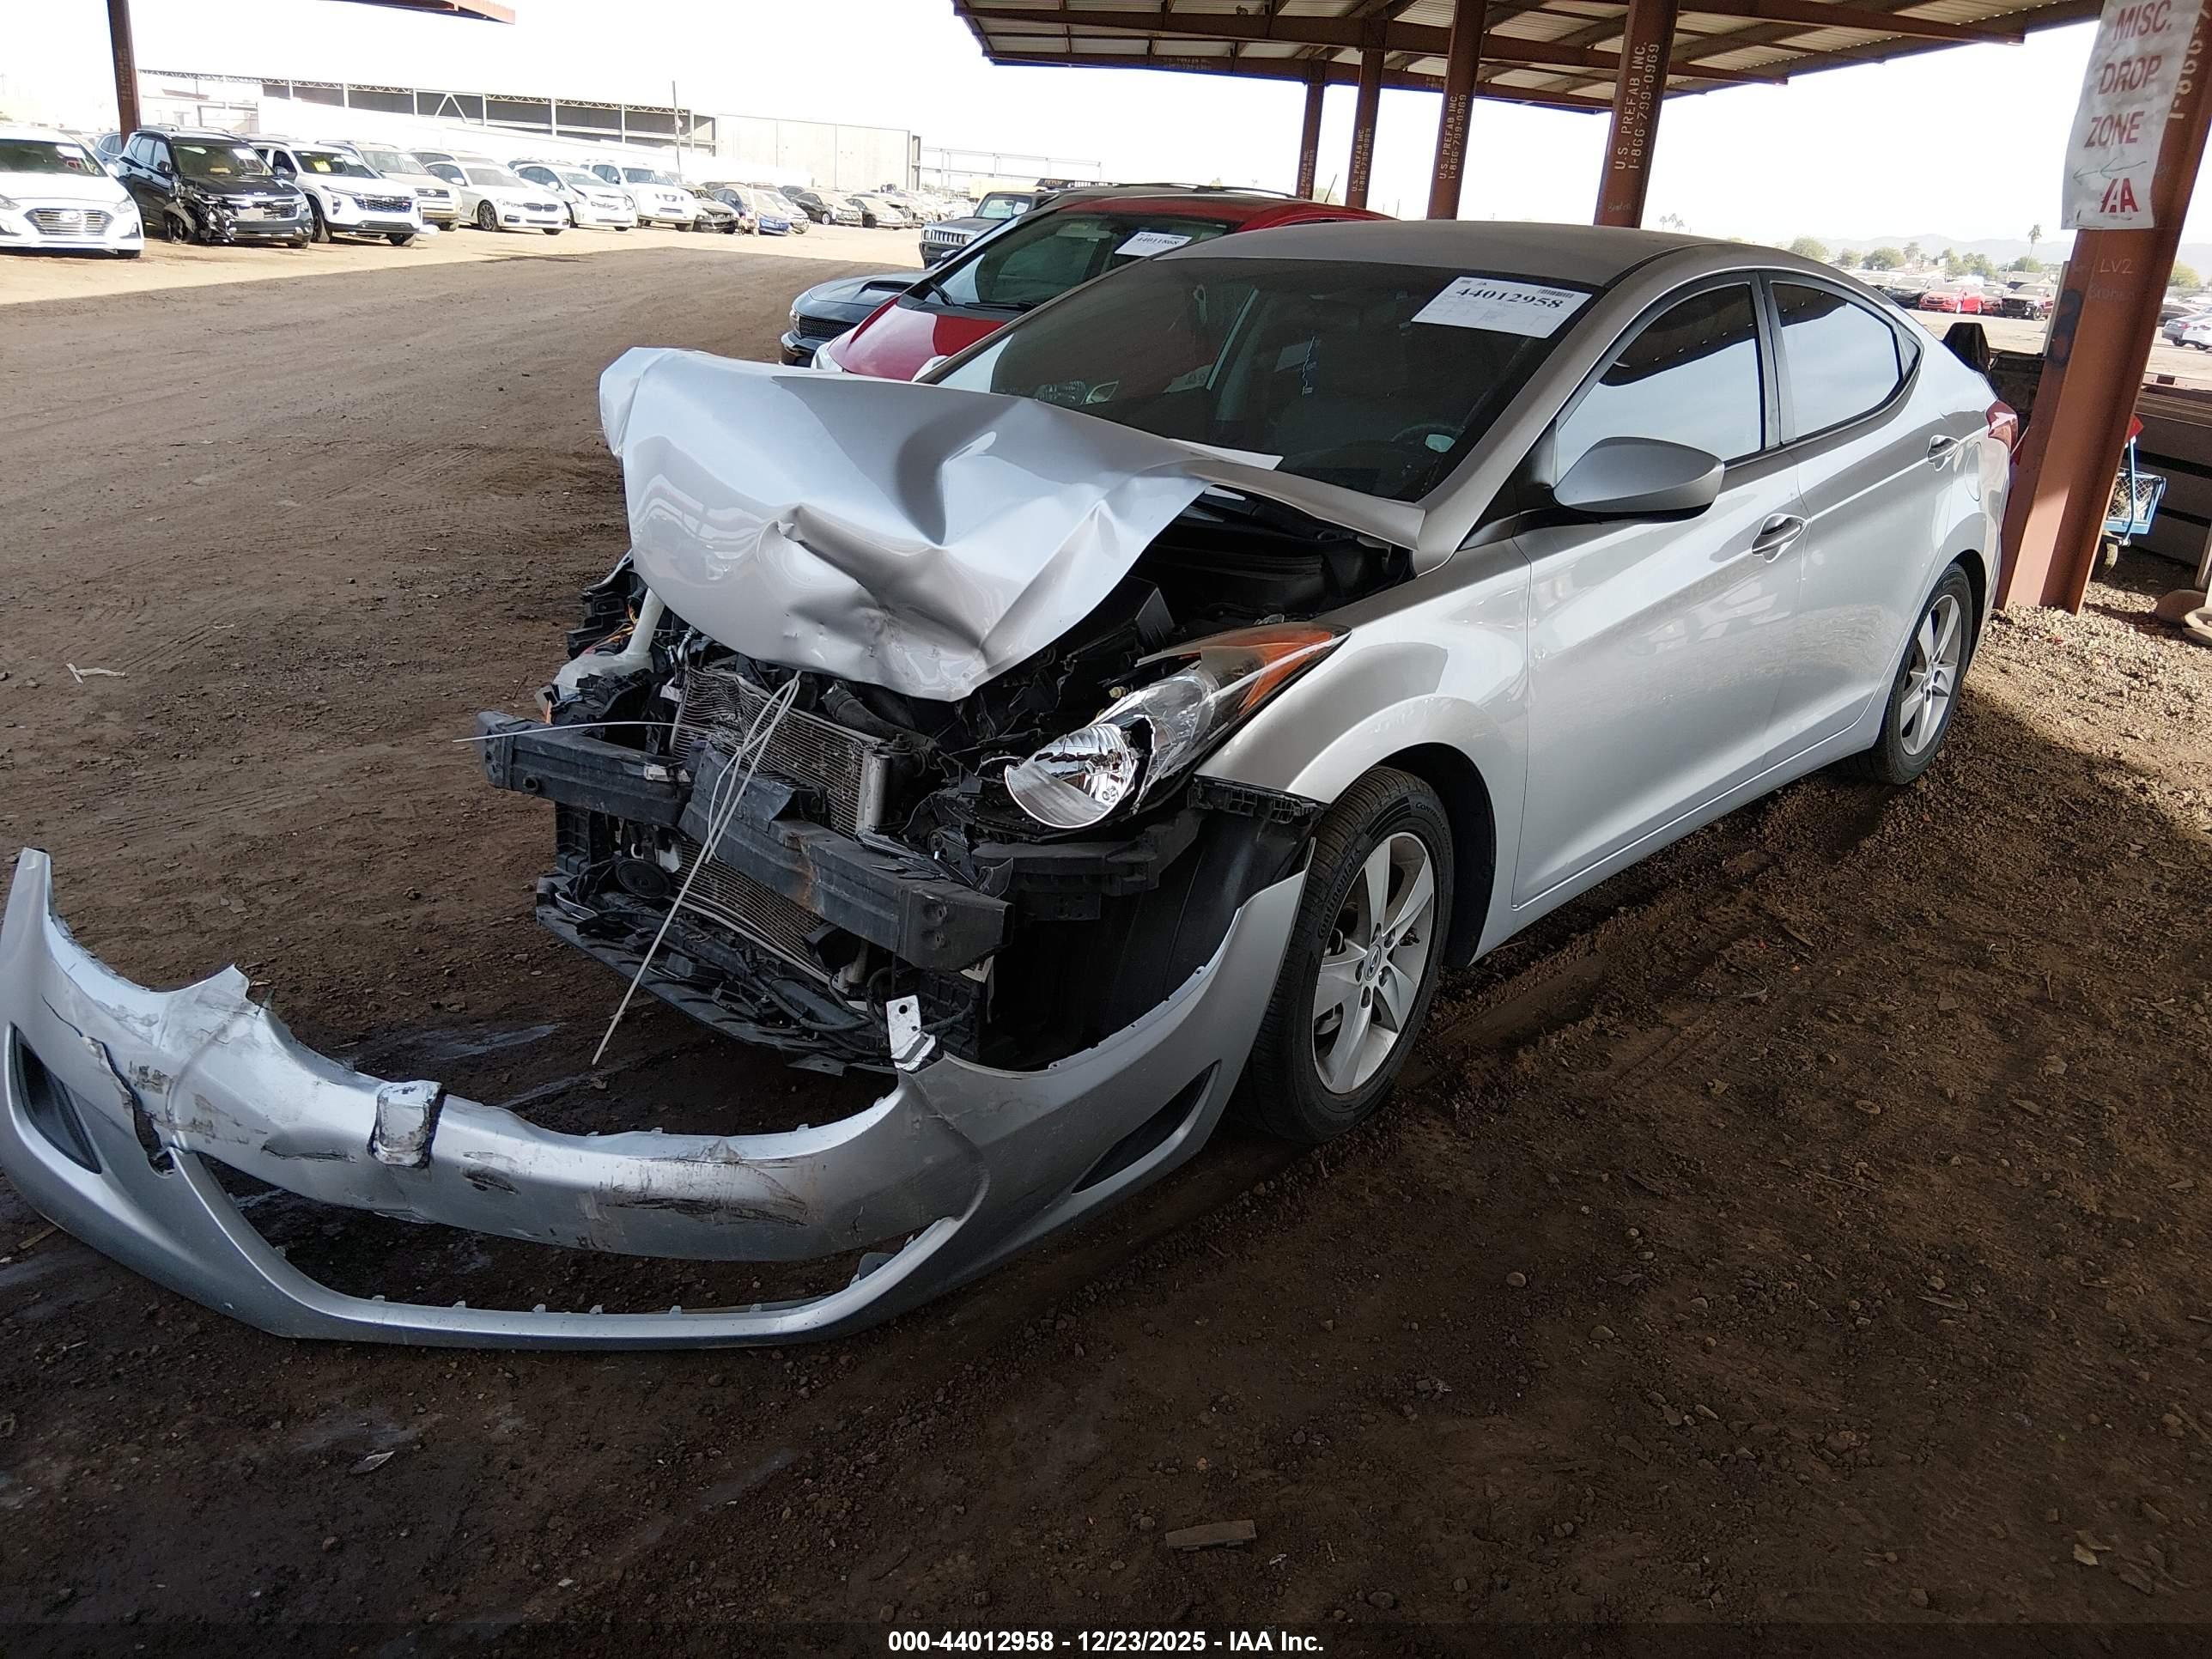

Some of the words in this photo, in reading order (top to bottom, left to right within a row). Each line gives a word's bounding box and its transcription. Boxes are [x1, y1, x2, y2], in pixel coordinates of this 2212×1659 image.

[2113, 0, 2172, 40] MISC.
[1632, 41, 1648, 70] INC.
[2098, 55, 2162, 94] DROP
[1621, 77, 1641, 134] PREFAB
[1628, 43, 1660, 169] 1-866-799-0969
[1443, 117, 1455, 155] PREFAB
[2084, 111, 2146, 149] ZONE
[1614, 142, 1630, 170] U.S.
[2099, 258, 2134, 275] LV2
[1456, 288, 1565, 309] 44012958
